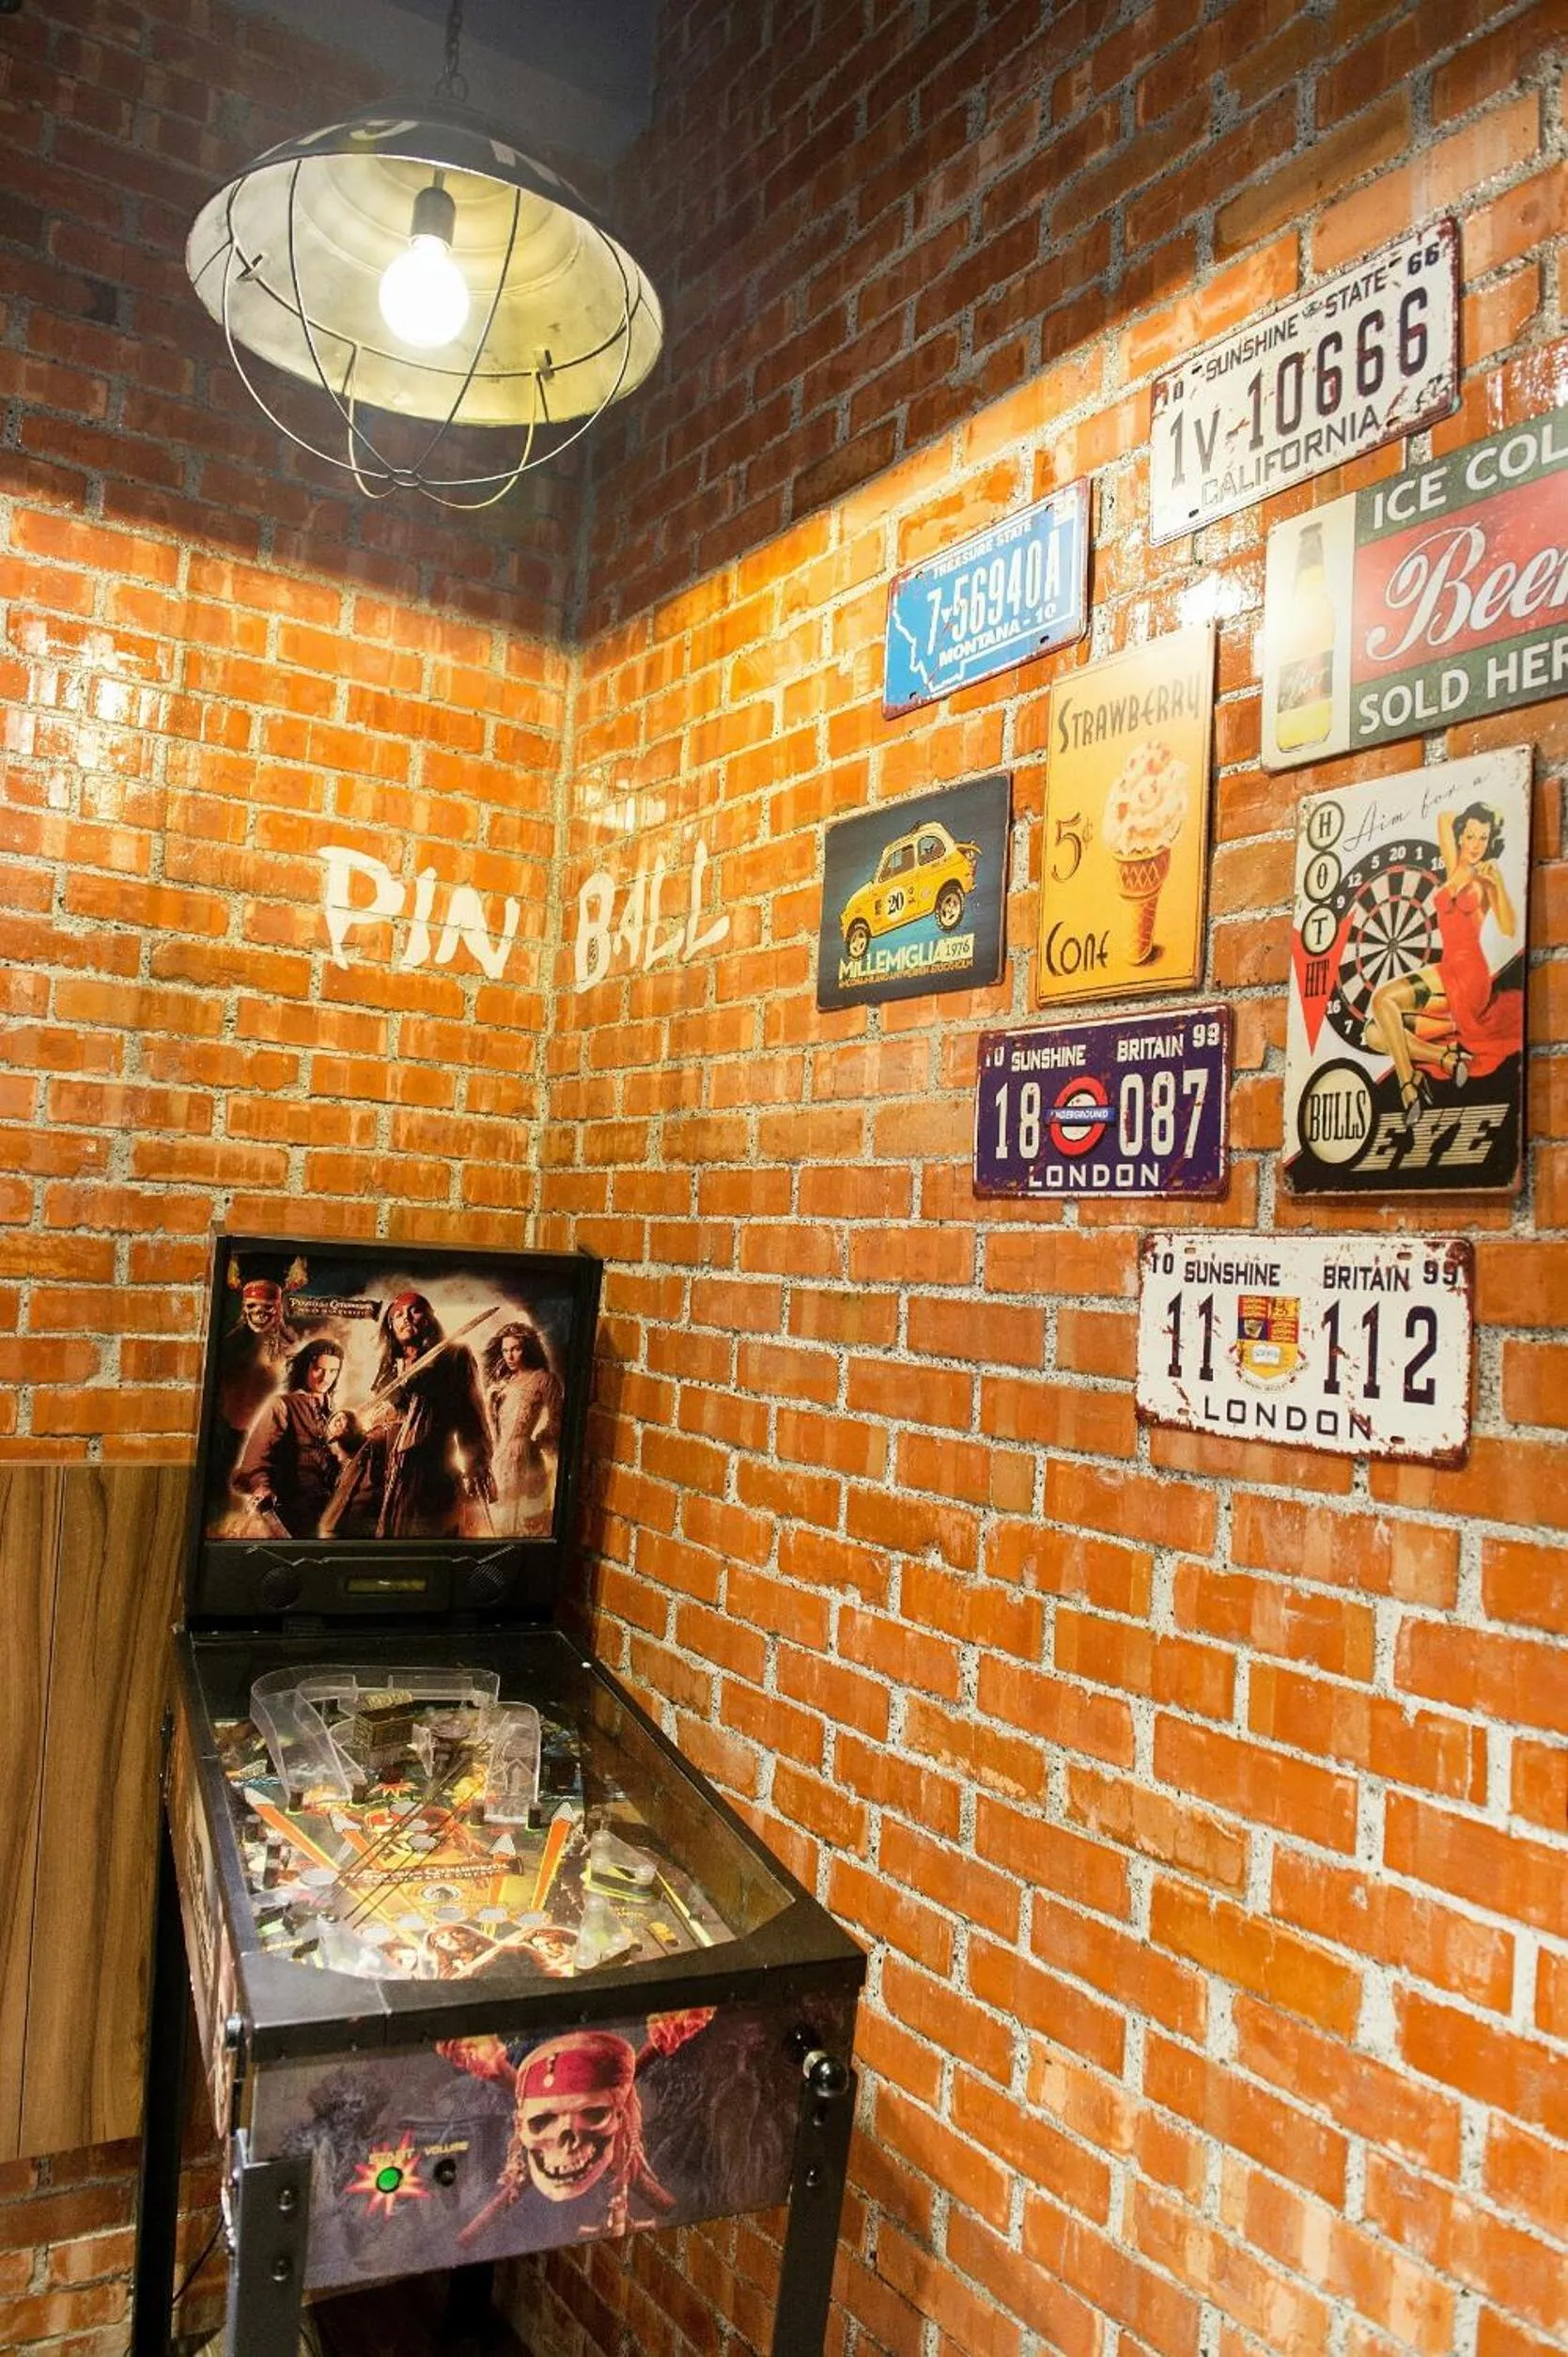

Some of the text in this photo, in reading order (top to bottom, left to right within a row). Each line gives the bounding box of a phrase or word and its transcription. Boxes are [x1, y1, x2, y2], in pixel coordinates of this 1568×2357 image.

[1205, 314, 1298, 382] SUNSHINE
[1325, 267, 1389, 318] STATE
[1407, 242, 1439, 275] 66
[1202, 405, 1382, 505] CALIFORNIA
[1374, 466, 1450, 529] ICE
[939, 619, 1021, 667] MONTANA
[1359, 669, 1469, 735] SOLD
[1343, 799, 1410, 852] Aim
[1371, 856, 1380, 870] 5
[1389, 845, 1407, 861] 20
[887, 892, 905, 916] 20
[1347, 873, 1362, 888] 12
[317, 839, 730, 994] PIN BALL
[1327, 1000, 1342, 1015] 16
[1011, 1045, 1087, 1072] SUNSHINE
[1116, 1034, 1185, 1063] BRITAIN
[1192, 1022, 1221, 1048] 99
[995, 1068, 1209, 1160] 18 087
[1307, 1090, 1367, 1142] BULLS
[1350, 1103, 1511, 1172] EYE
[1028, 1162, 1160, 1188] LONDON
[1184, 1261, 1281, 1287] SUNSHINE
[1323, 1264, 1410, 1293] BRITAIN
[1422, 1260, 1458, 1286] 99
[1167, 1291, 1438, 1405] 11 112
[1203, 1394, 1374, 1441] LONDON
